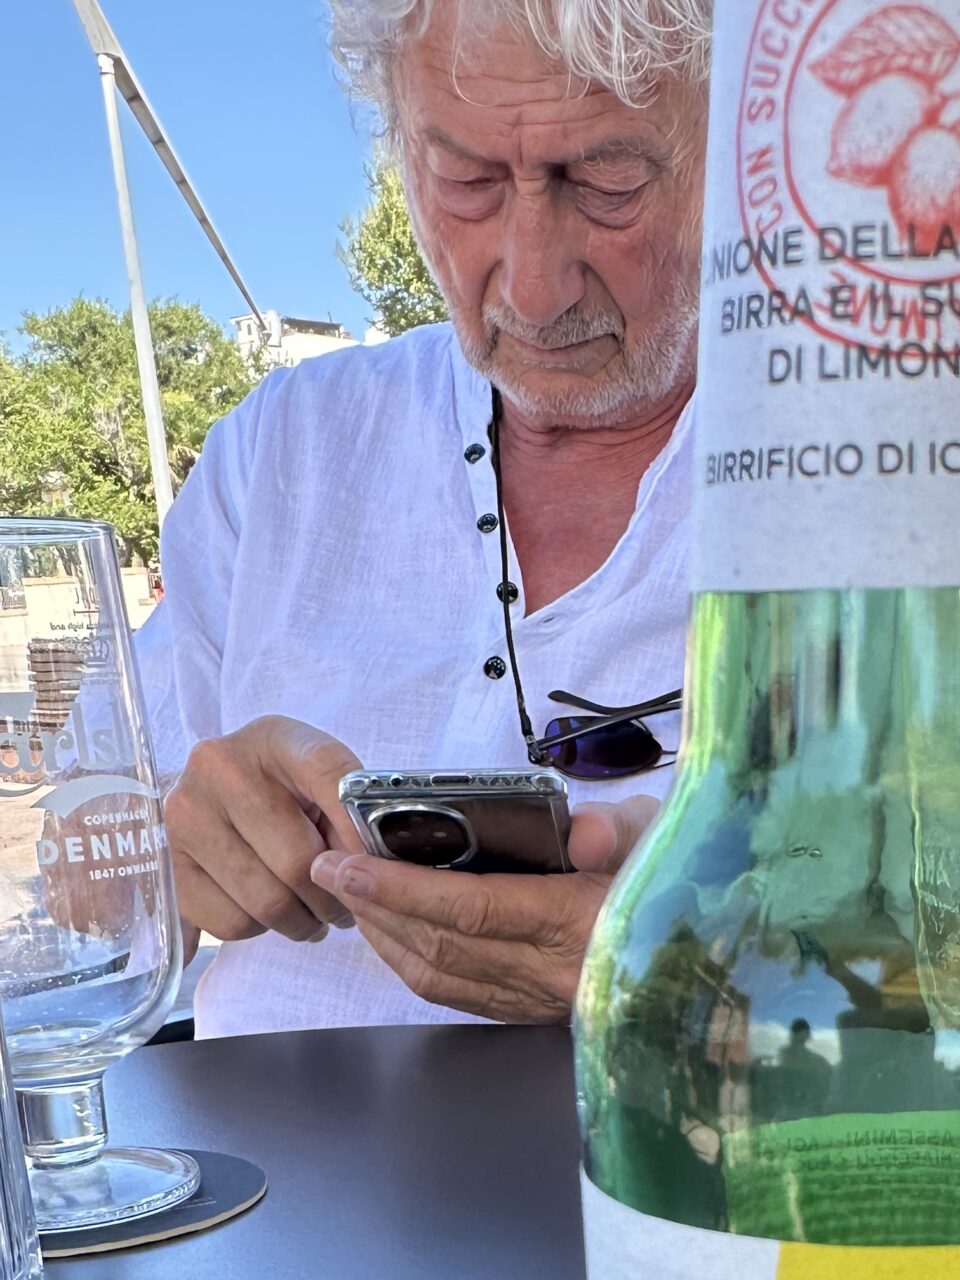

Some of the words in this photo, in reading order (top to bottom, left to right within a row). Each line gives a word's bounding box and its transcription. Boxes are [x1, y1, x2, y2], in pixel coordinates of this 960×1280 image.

[747, 0, 806, 126] SUCC
[747, 146, 784, 233] CON
[706, 225, 804, 286] NIONE
[818, 223, 960, 263] DELLA
[720, 286, 816, 334] BIRRA
[870, 280, 900, 319] IL
[768, 346, 803, 384] DI
[706, 443, 864, 487] BIRRIFICIO
[877, 441, 915, 476] DI
